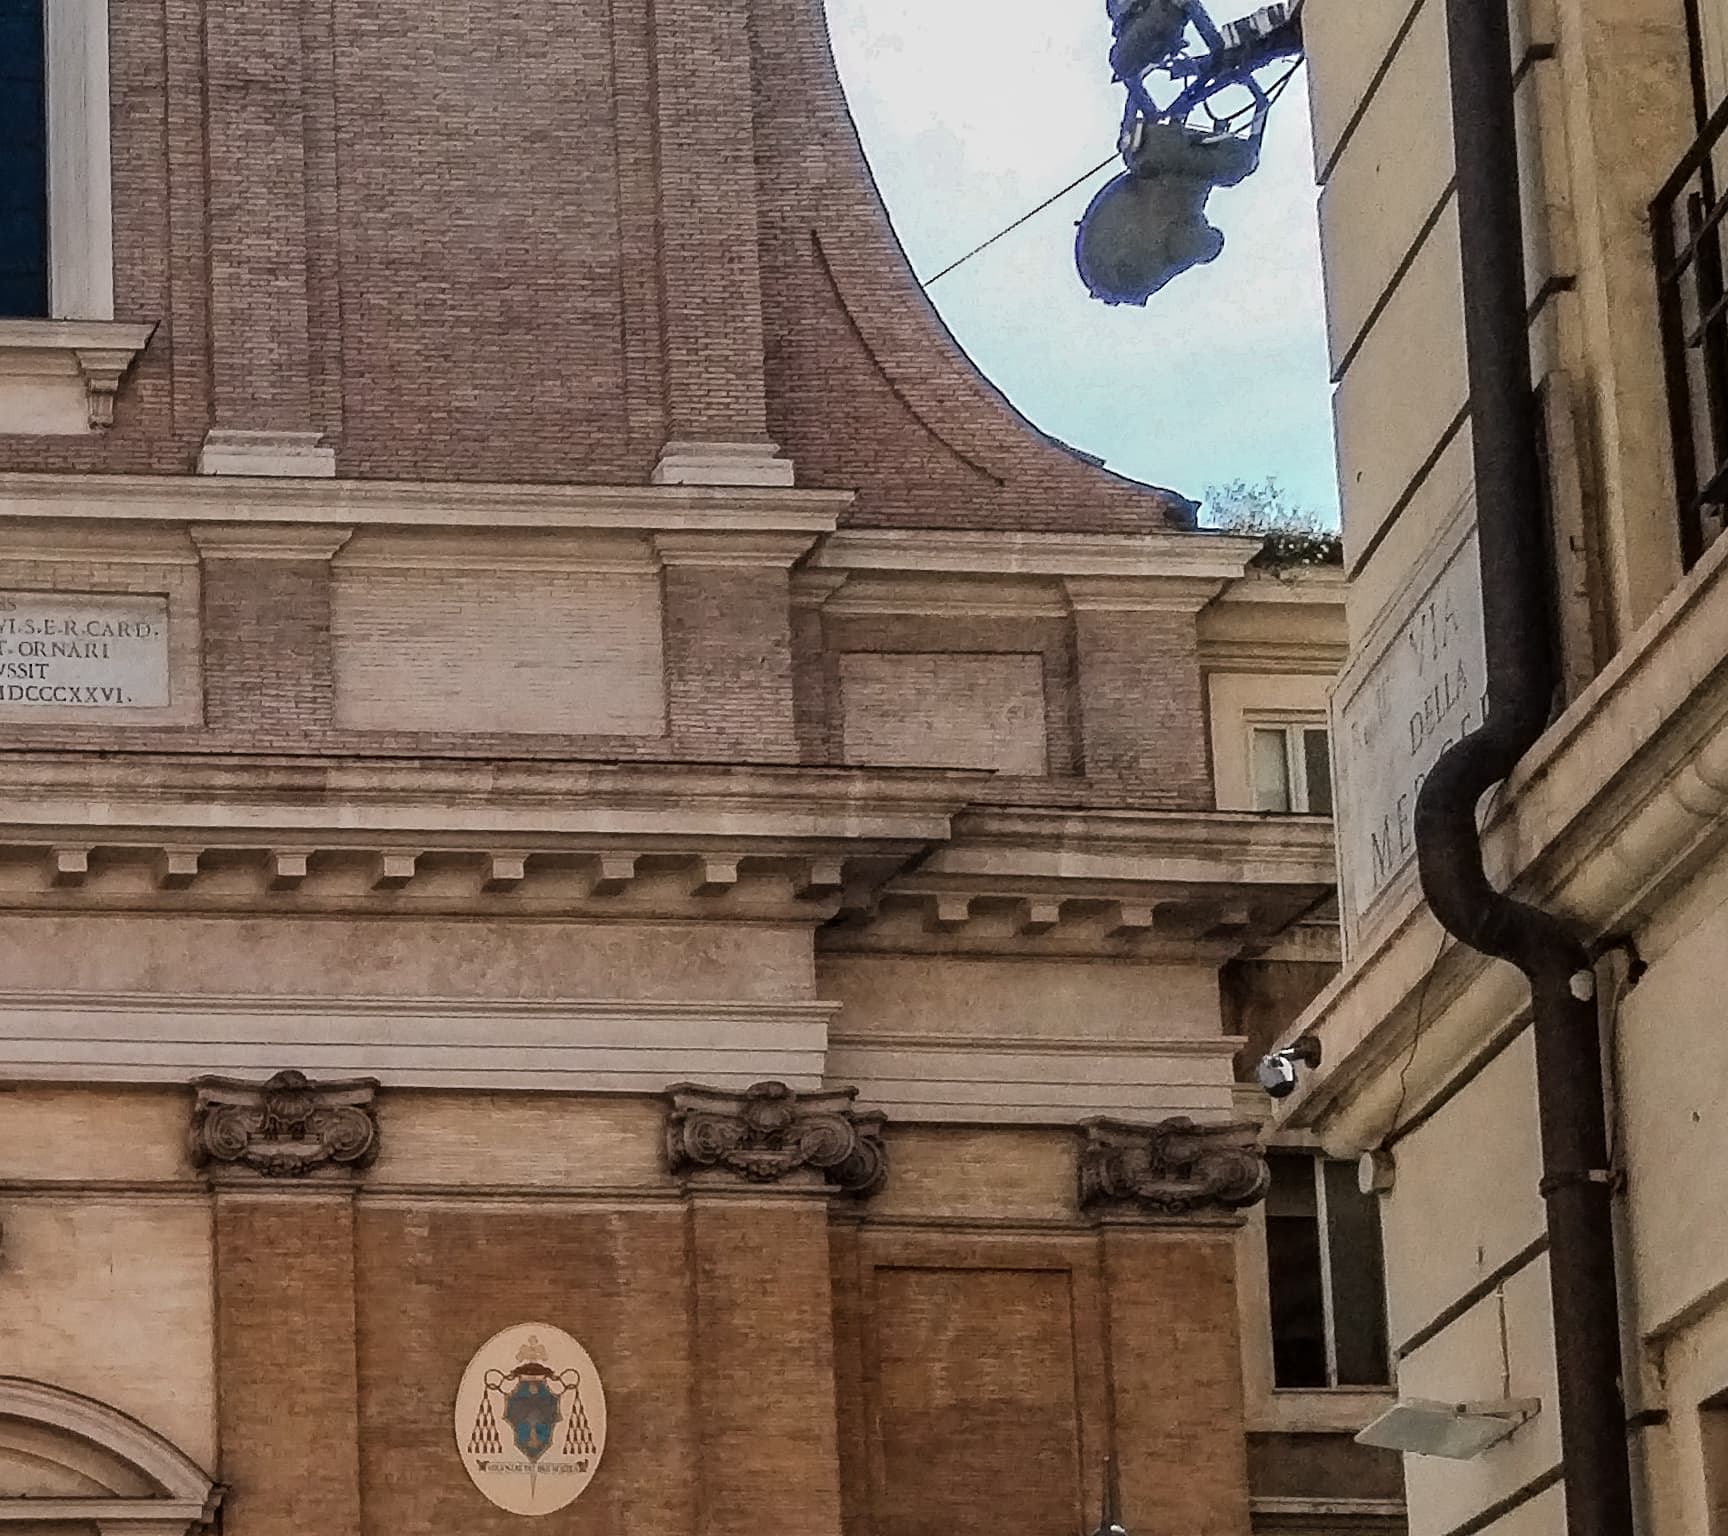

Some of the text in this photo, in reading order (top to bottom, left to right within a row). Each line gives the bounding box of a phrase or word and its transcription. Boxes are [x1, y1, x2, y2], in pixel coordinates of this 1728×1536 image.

[17, 640, 110, 659] ORNARI
[1408, 588, 1459, 677] VIA
[1410, 658, 1468, 757] DELLA
